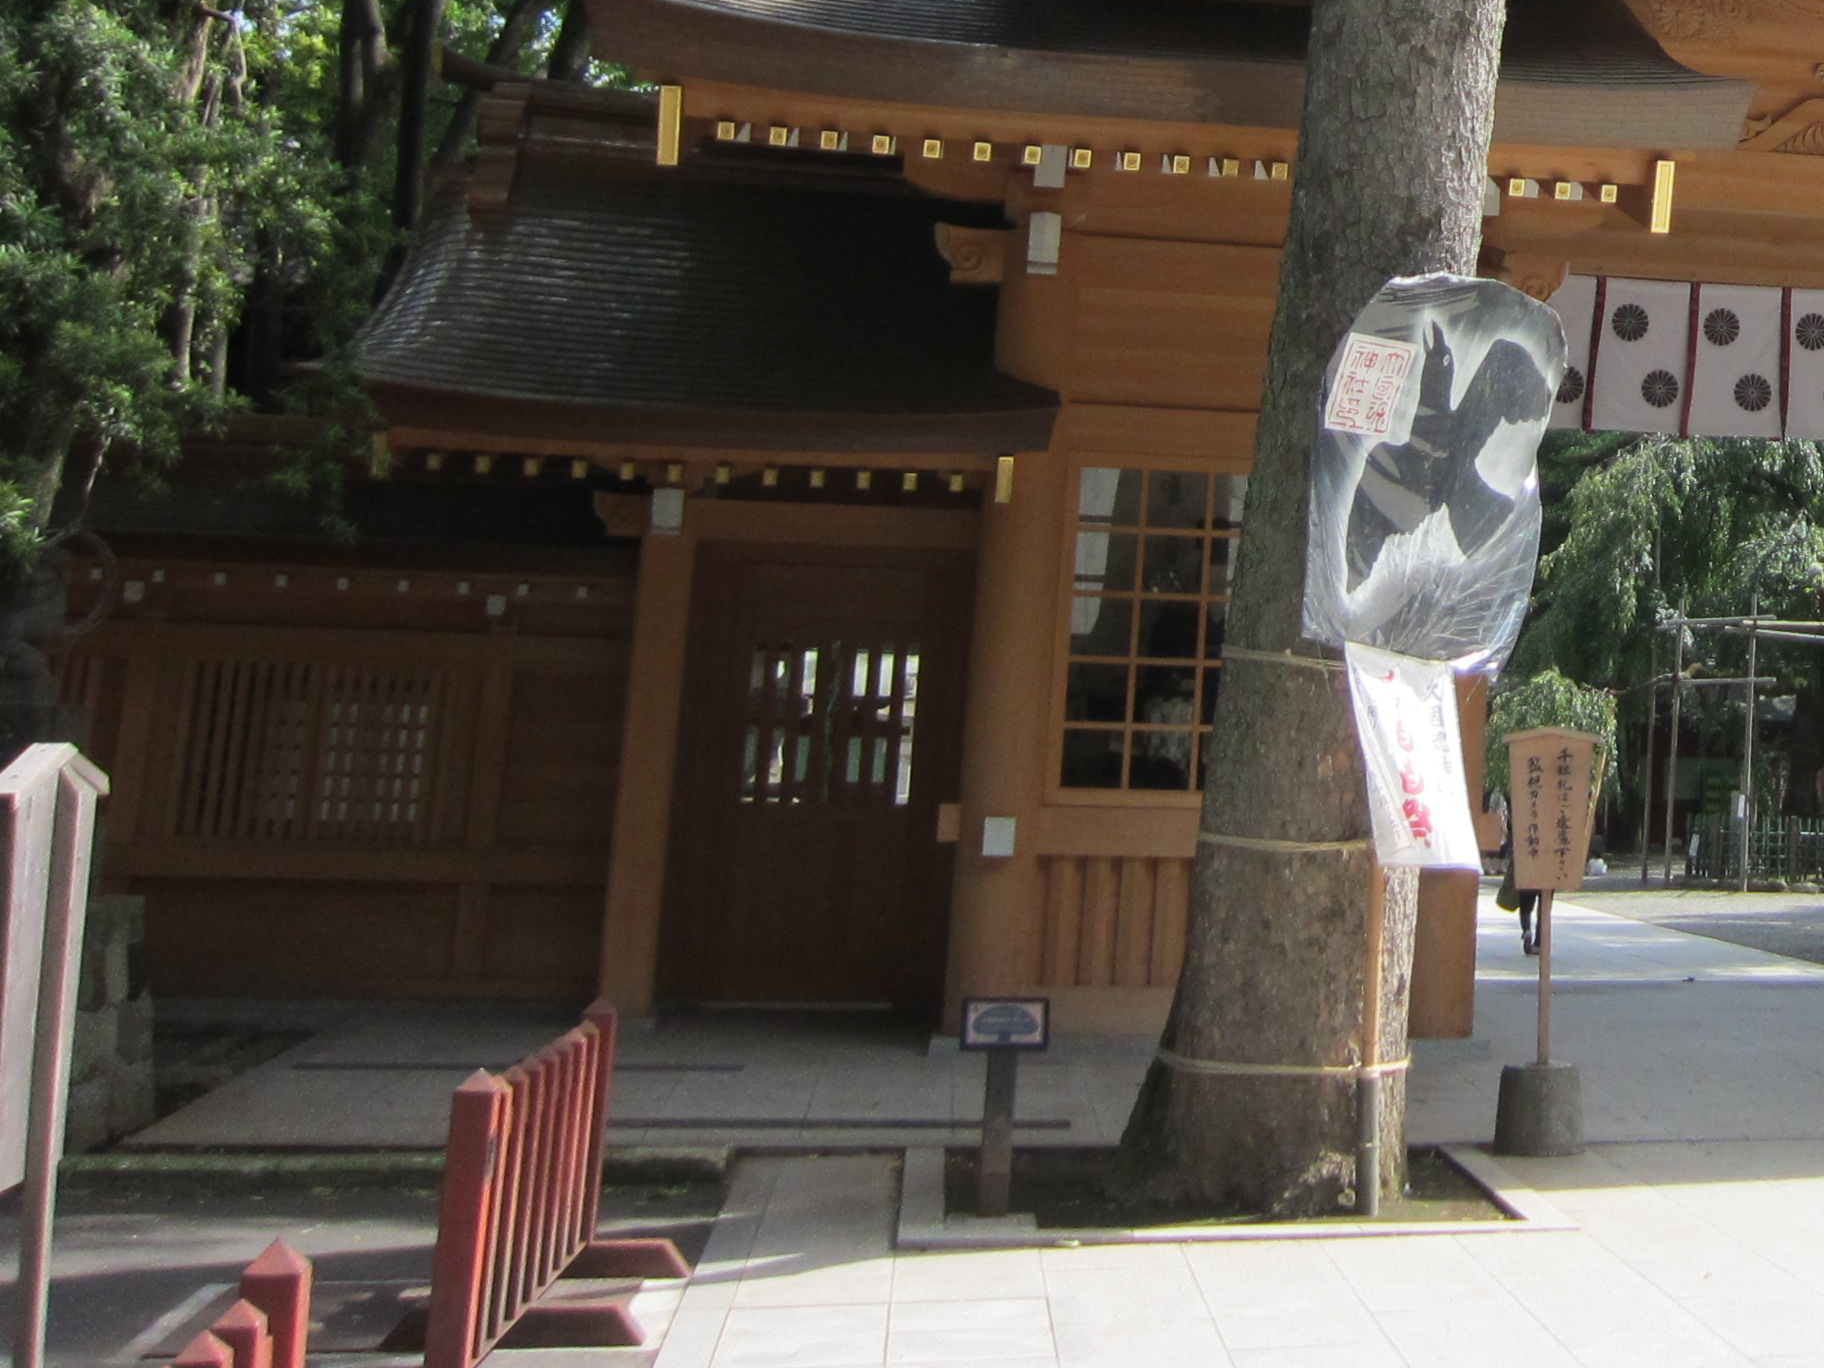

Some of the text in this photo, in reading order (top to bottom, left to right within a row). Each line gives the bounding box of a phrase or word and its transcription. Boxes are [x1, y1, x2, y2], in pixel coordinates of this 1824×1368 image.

[1526, 756, 1544, 860] 監視カメラ作動中
